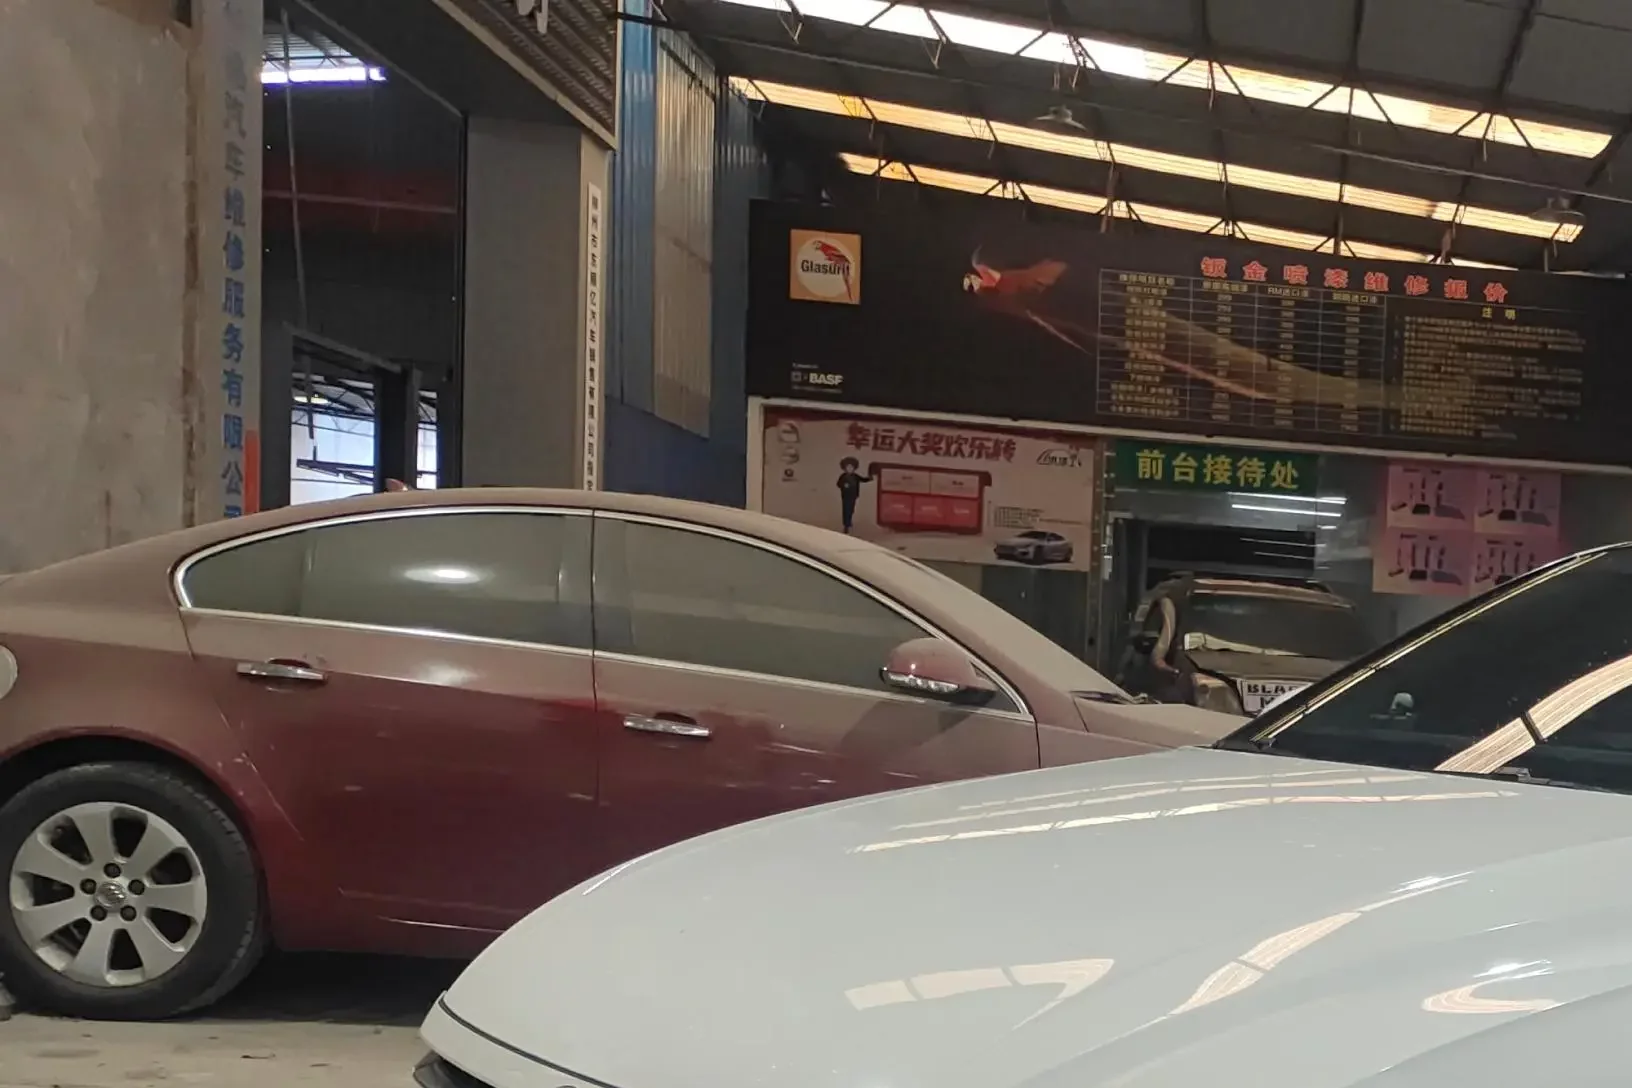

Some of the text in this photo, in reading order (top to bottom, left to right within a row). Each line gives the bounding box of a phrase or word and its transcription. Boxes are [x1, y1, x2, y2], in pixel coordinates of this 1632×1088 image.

[221, 50, 247, 518] 汽车维修服务有限公
[809, 372, 844, 387] BASF
[1136, 449, 1299, 489] 前台接待处
